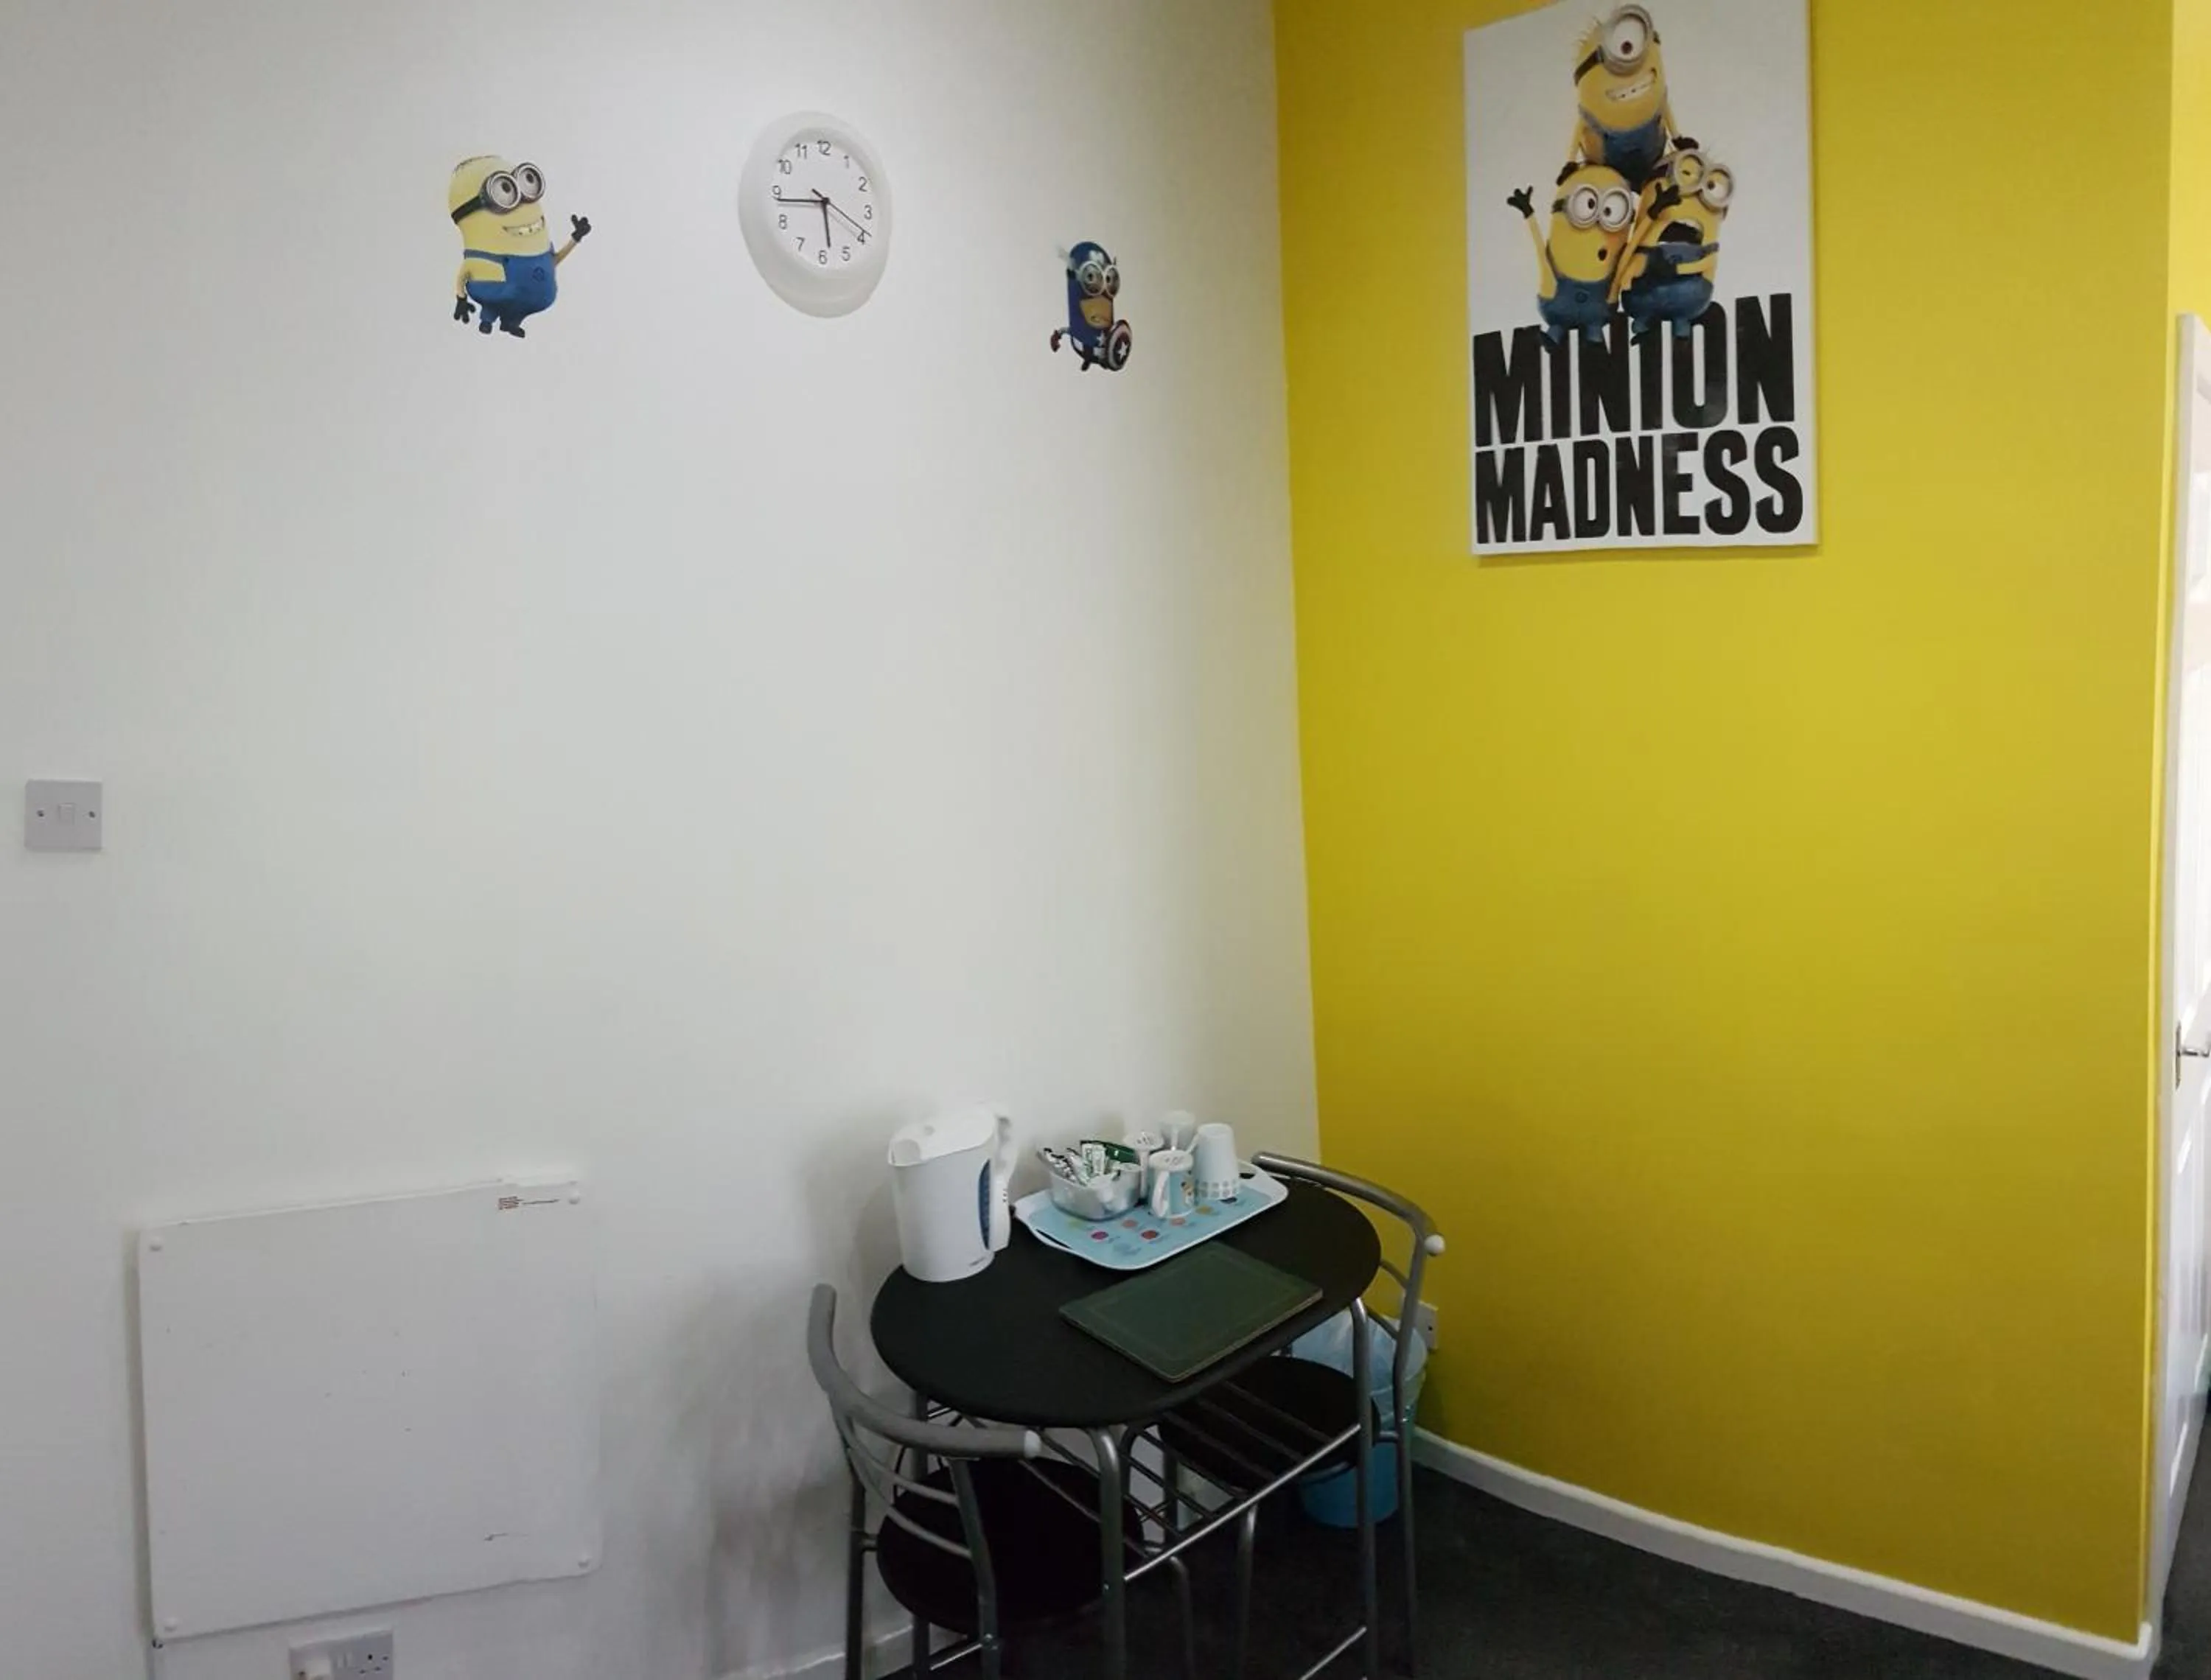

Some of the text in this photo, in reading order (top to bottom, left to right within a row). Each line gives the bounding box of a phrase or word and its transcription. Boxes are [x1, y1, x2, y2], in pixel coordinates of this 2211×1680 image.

[794, 143, 808, 160] 11
[817, 140, 832, 156] 12
[778, 158, 792, 175] 10
[843, 155, 850, 169] 1
[858, 176, 868, 192] 2
[863, 204, 873, 220] 3
[778, 214, 788, 230] 8
[795, 237, 806, 252] 7
[857, 230, 866, 245] 4
[818, 250, 828, 266] 6
[840, 246, 851, 262] 5
[1473, 293, 1795, 447] MINION
[1475, 426, 1803, 545] MADNESS
